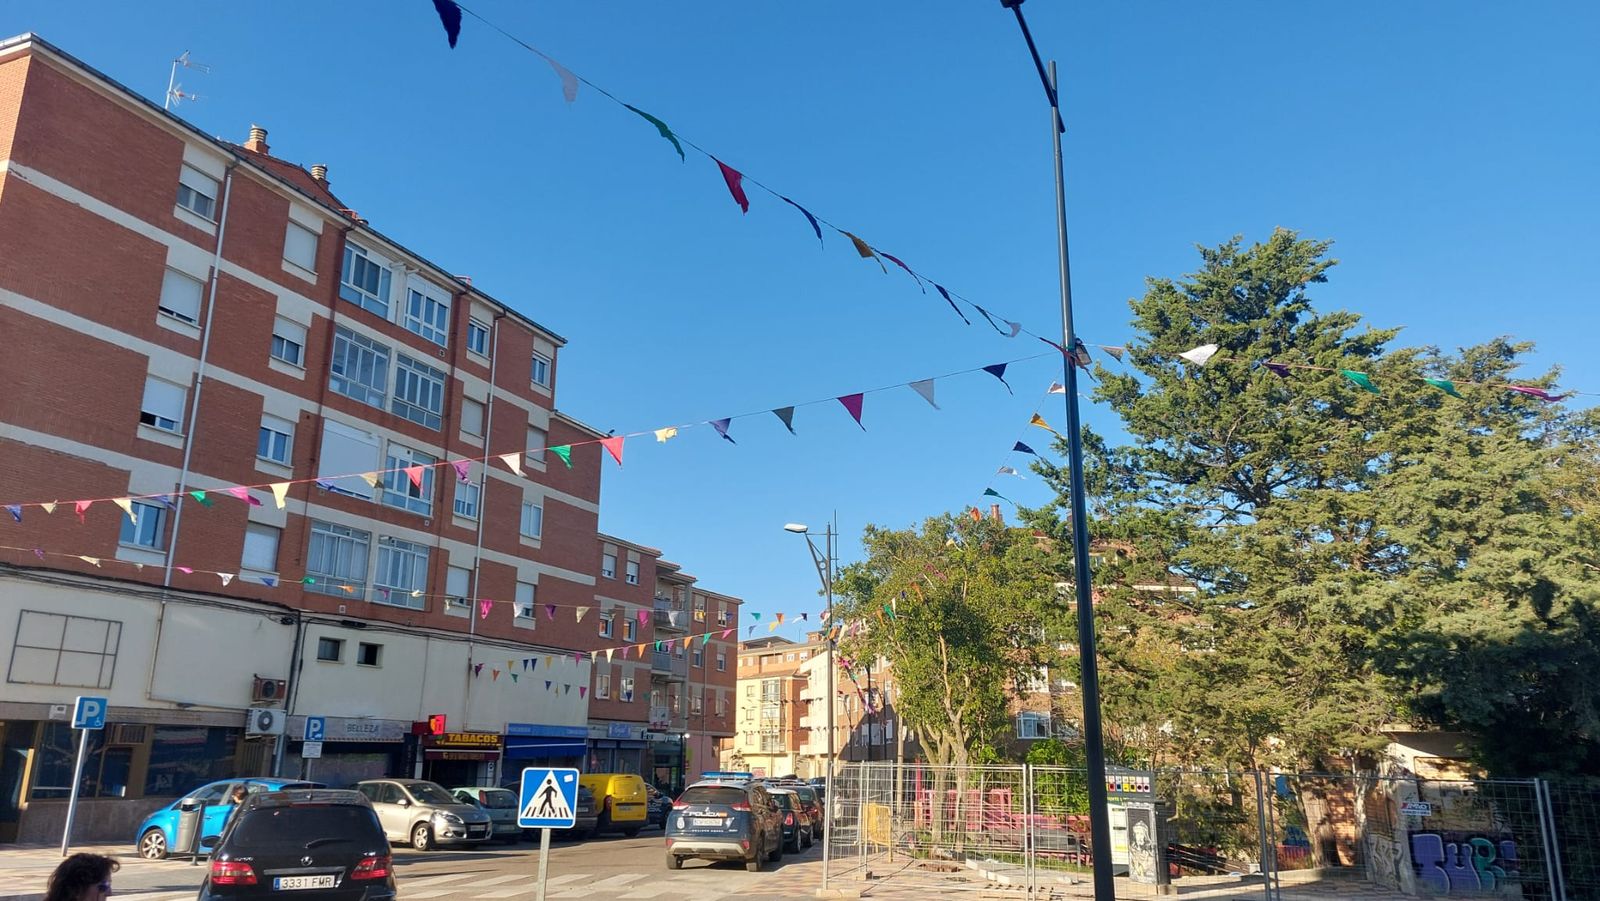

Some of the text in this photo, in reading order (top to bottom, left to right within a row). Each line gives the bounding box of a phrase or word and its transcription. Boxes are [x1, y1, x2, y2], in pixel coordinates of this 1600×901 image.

[81, 701, 100, 725] P
[308, 719, 322, 738] P
[346, 723, 380, 733] BELLEZA
[447, 733, 498, 743] TABACOS
[282, 875, 333, 889] 3331 FMR
